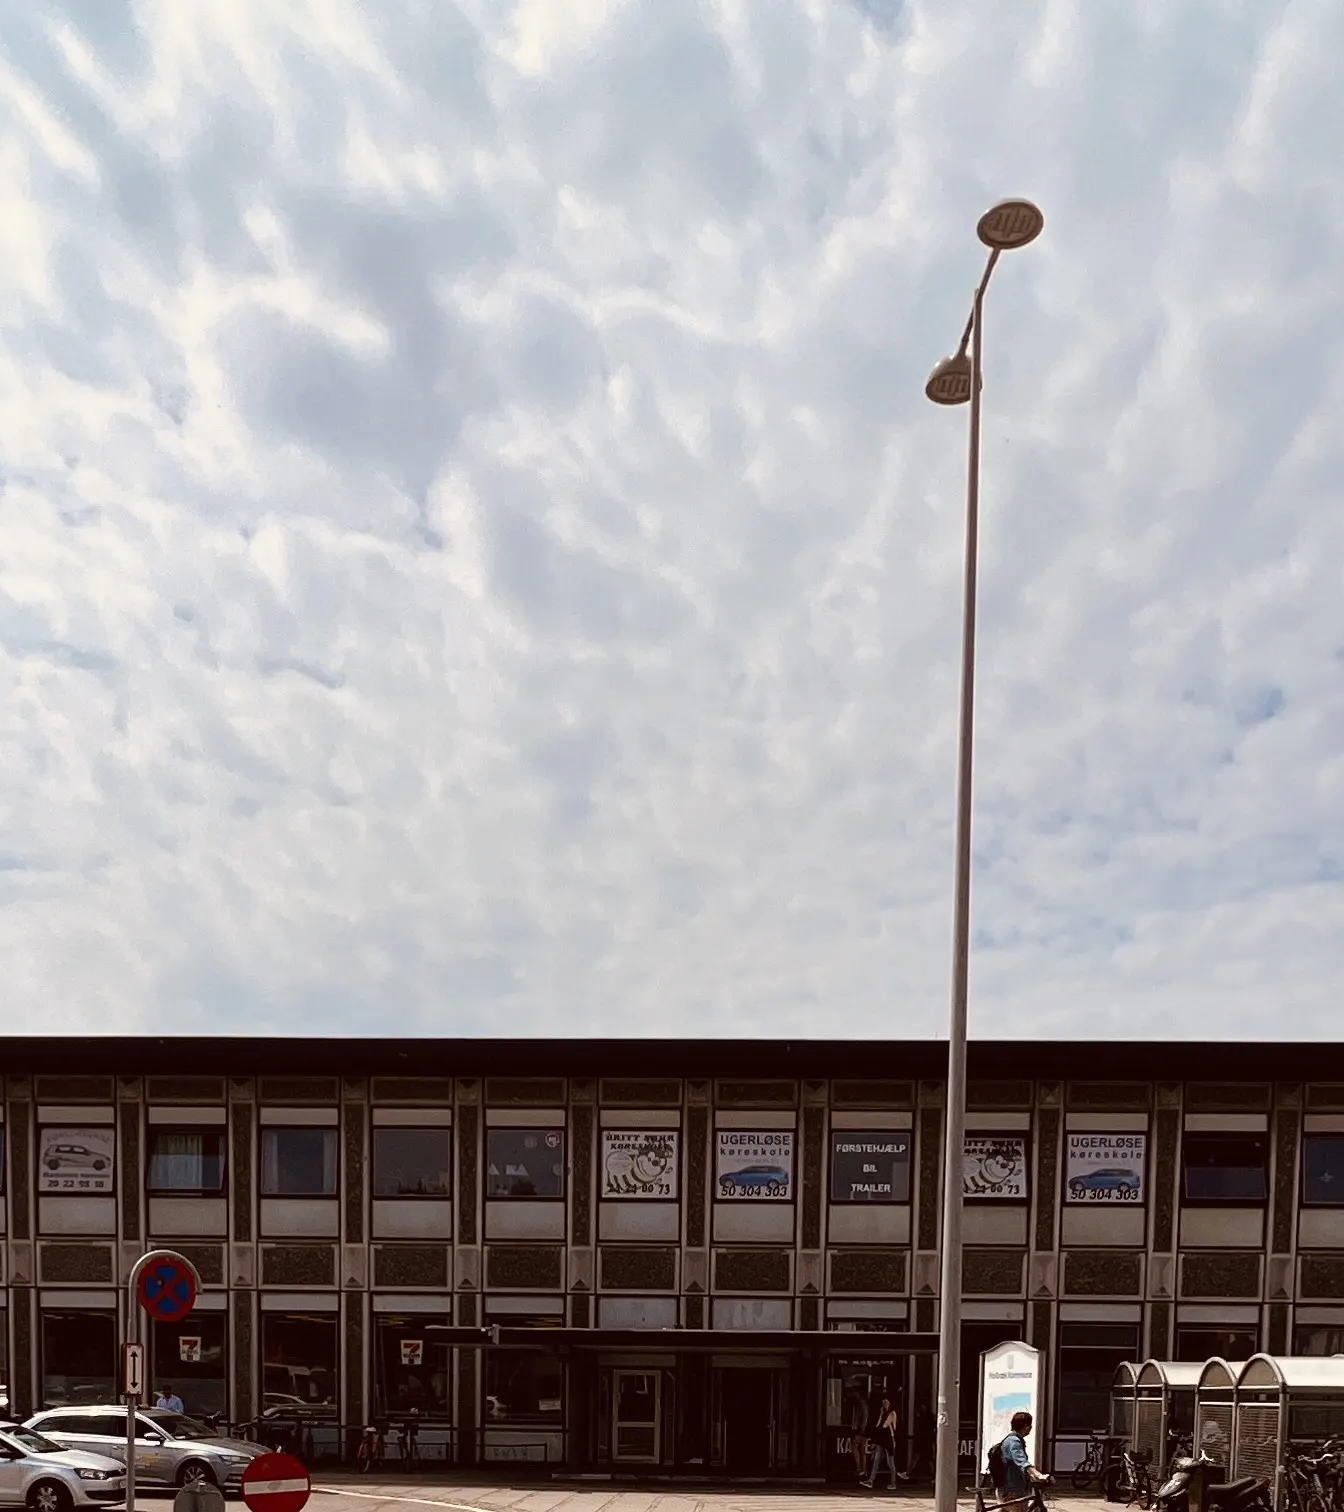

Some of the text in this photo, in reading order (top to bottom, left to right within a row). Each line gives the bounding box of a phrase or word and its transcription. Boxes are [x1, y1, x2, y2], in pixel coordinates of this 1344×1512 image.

[720, 1134, 790, 1146] UGERLØSE
[1071, 1137, 1143, 1149] UGERLØSE
[836, 1143, 906, 1153] FØRSTEHJÆLP
[658, 1183, 671, 1195] 73
[721, 1185, 788, 1197] 50 304 303
[851, 1183, 891, 1193] TRAILER
[1007, 1184, 1020, 1195] 73
[1070, 1188, 1138, 1200] 50 304 303
[836, 1437, 873, 1454] KAE
